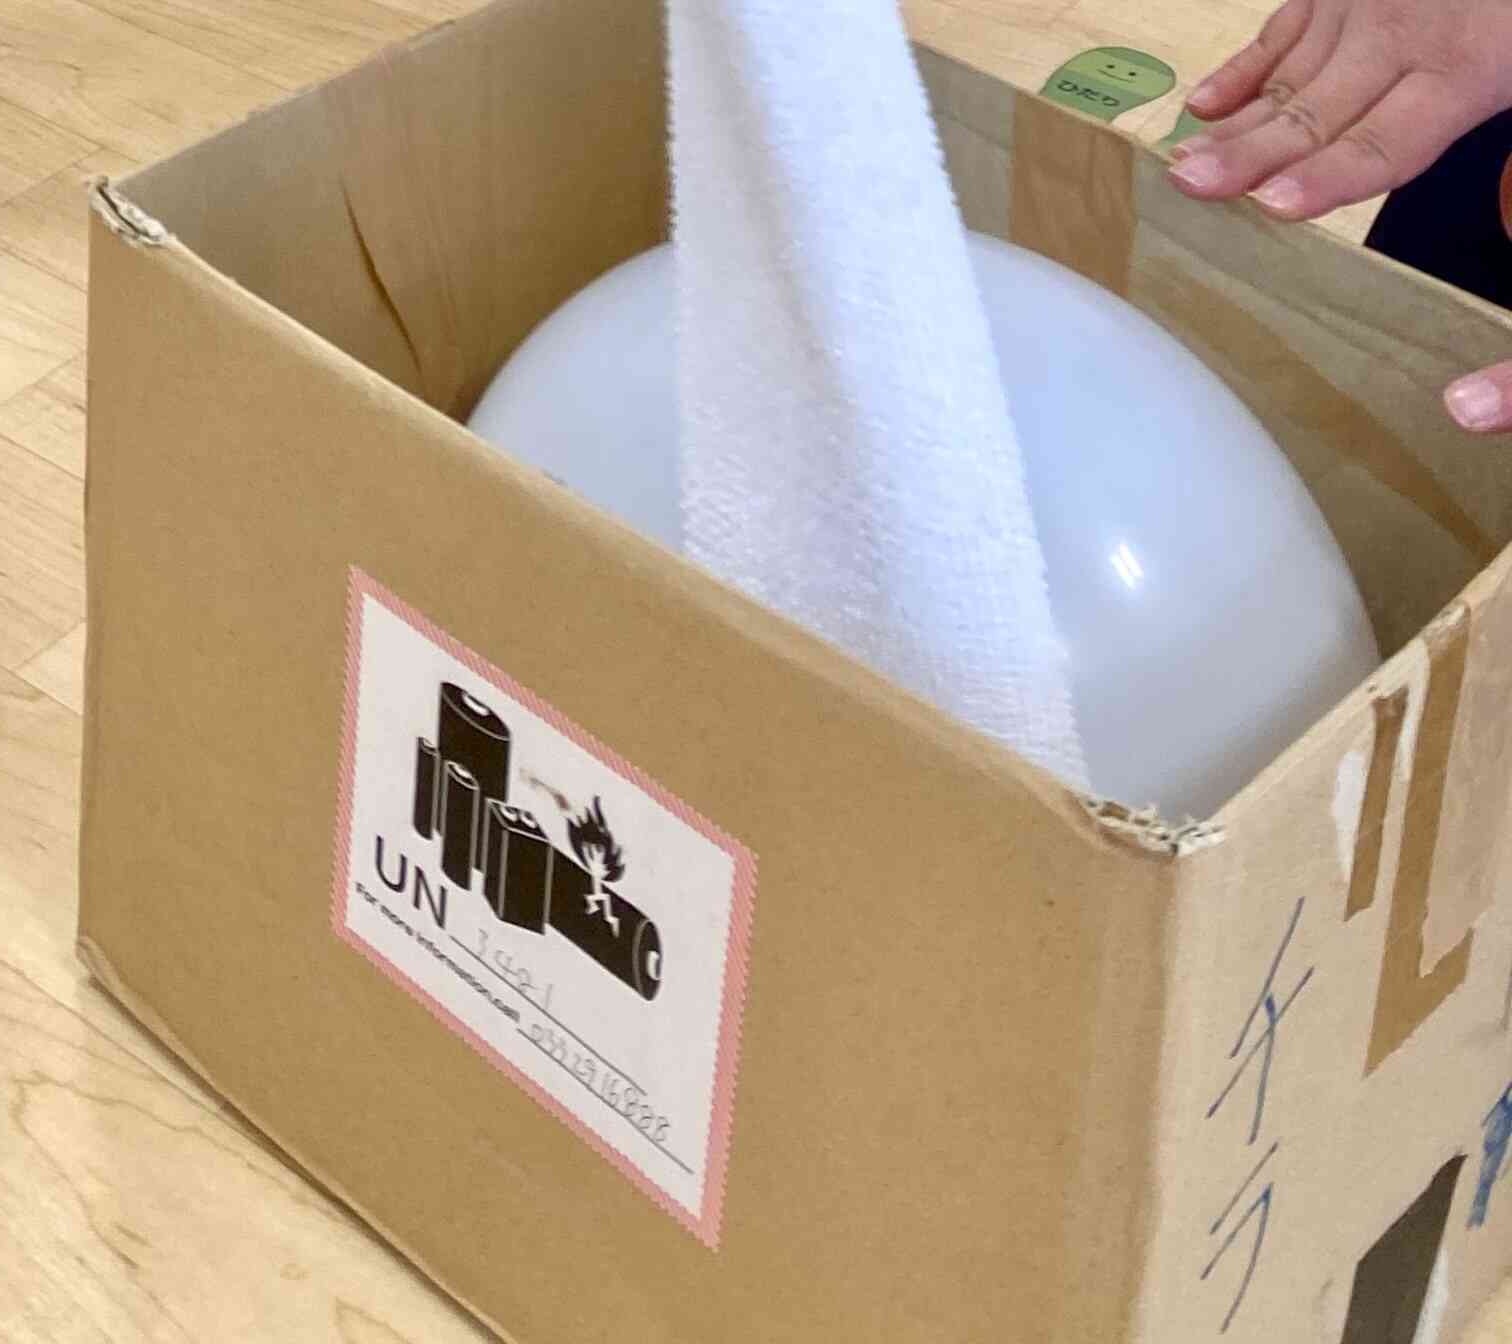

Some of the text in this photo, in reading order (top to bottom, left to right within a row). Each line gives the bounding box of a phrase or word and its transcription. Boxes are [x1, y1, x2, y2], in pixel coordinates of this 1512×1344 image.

[1056, 79, 1121, 107] ひだり
[374, 834, 448, 931] UN
